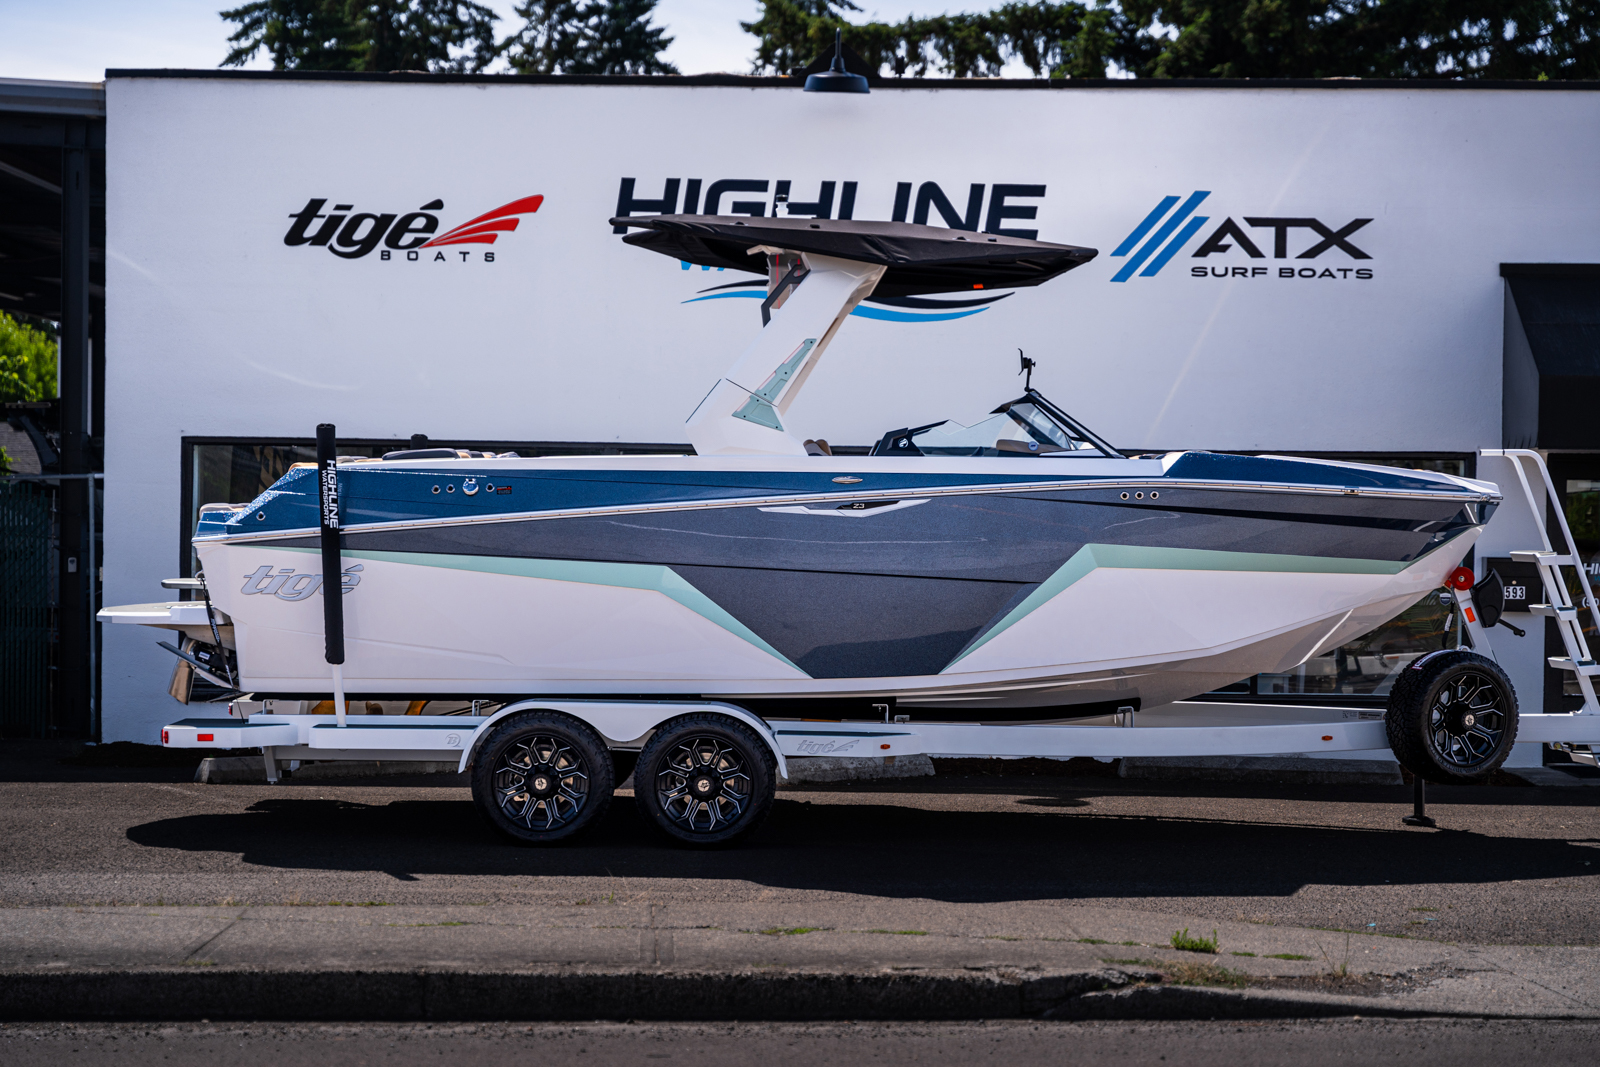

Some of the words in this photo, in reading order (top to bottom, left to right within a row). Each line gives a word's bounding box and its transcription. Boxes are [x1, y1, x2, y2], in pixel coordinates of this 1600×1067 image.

[283, 198, 444, 259] tigé
[1191, 216, 1374, 260] ATX
[380, 250, 495, 262] BOATS
[1191, 266, 1268, 278] SURF
[1278, 267, 1374, 279] BOATS
[321, 469, 330, 525] WATERSPORTS
[326, 459, 339, 529] HIGHLINE
[1505, 587, 1524, 598] 593
